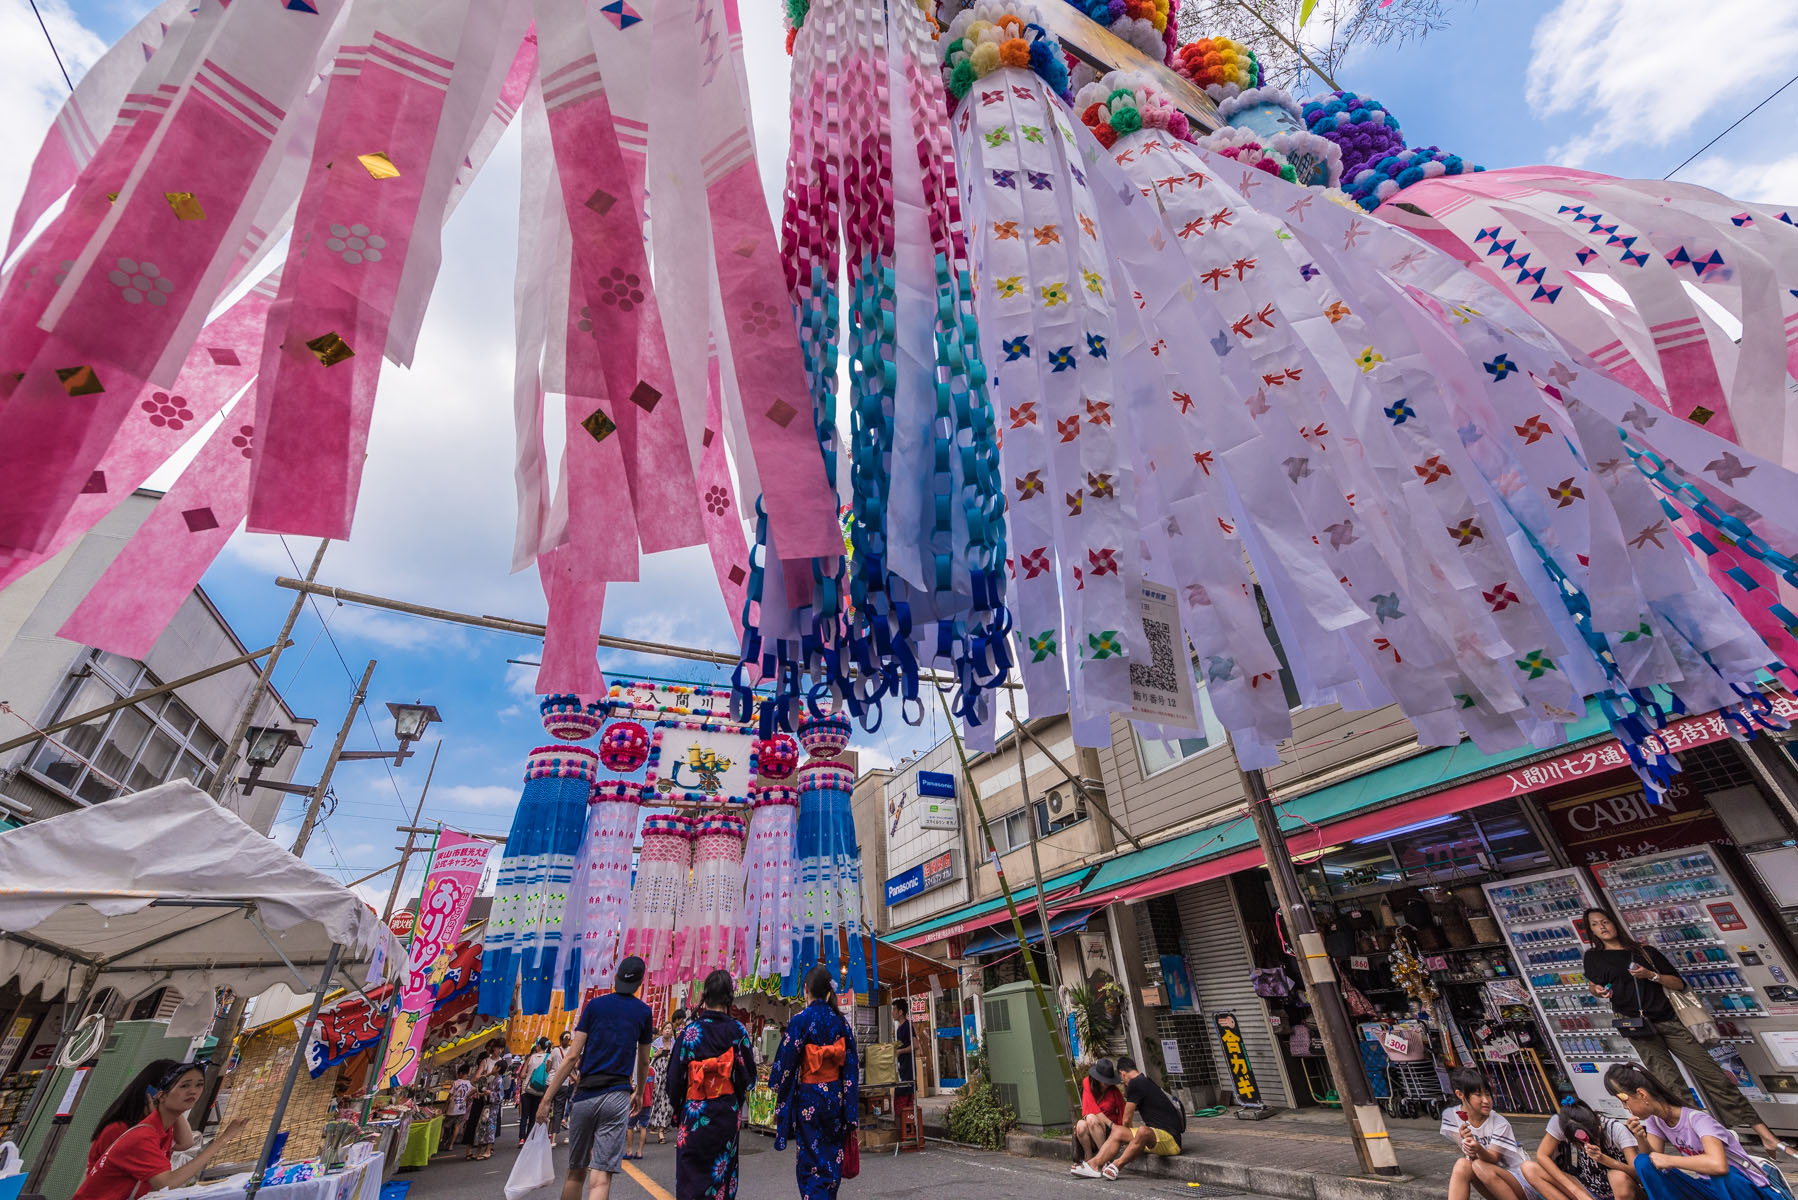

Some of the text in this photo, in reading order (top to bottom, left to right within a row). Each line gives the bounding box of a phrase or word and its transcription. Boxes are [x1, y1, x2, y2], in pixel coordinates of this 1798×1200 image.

[1167, 697, 1177, 708] 12
[922, 779, 954, 790] Panasonic
[1567, 791, 1680, 832] CABIN
[434, 858, 483, 870] 公式キャラクター
[888, 875, 919, 898] Panasonic
[1222, 1029, 1255, 1099] 合カギ
